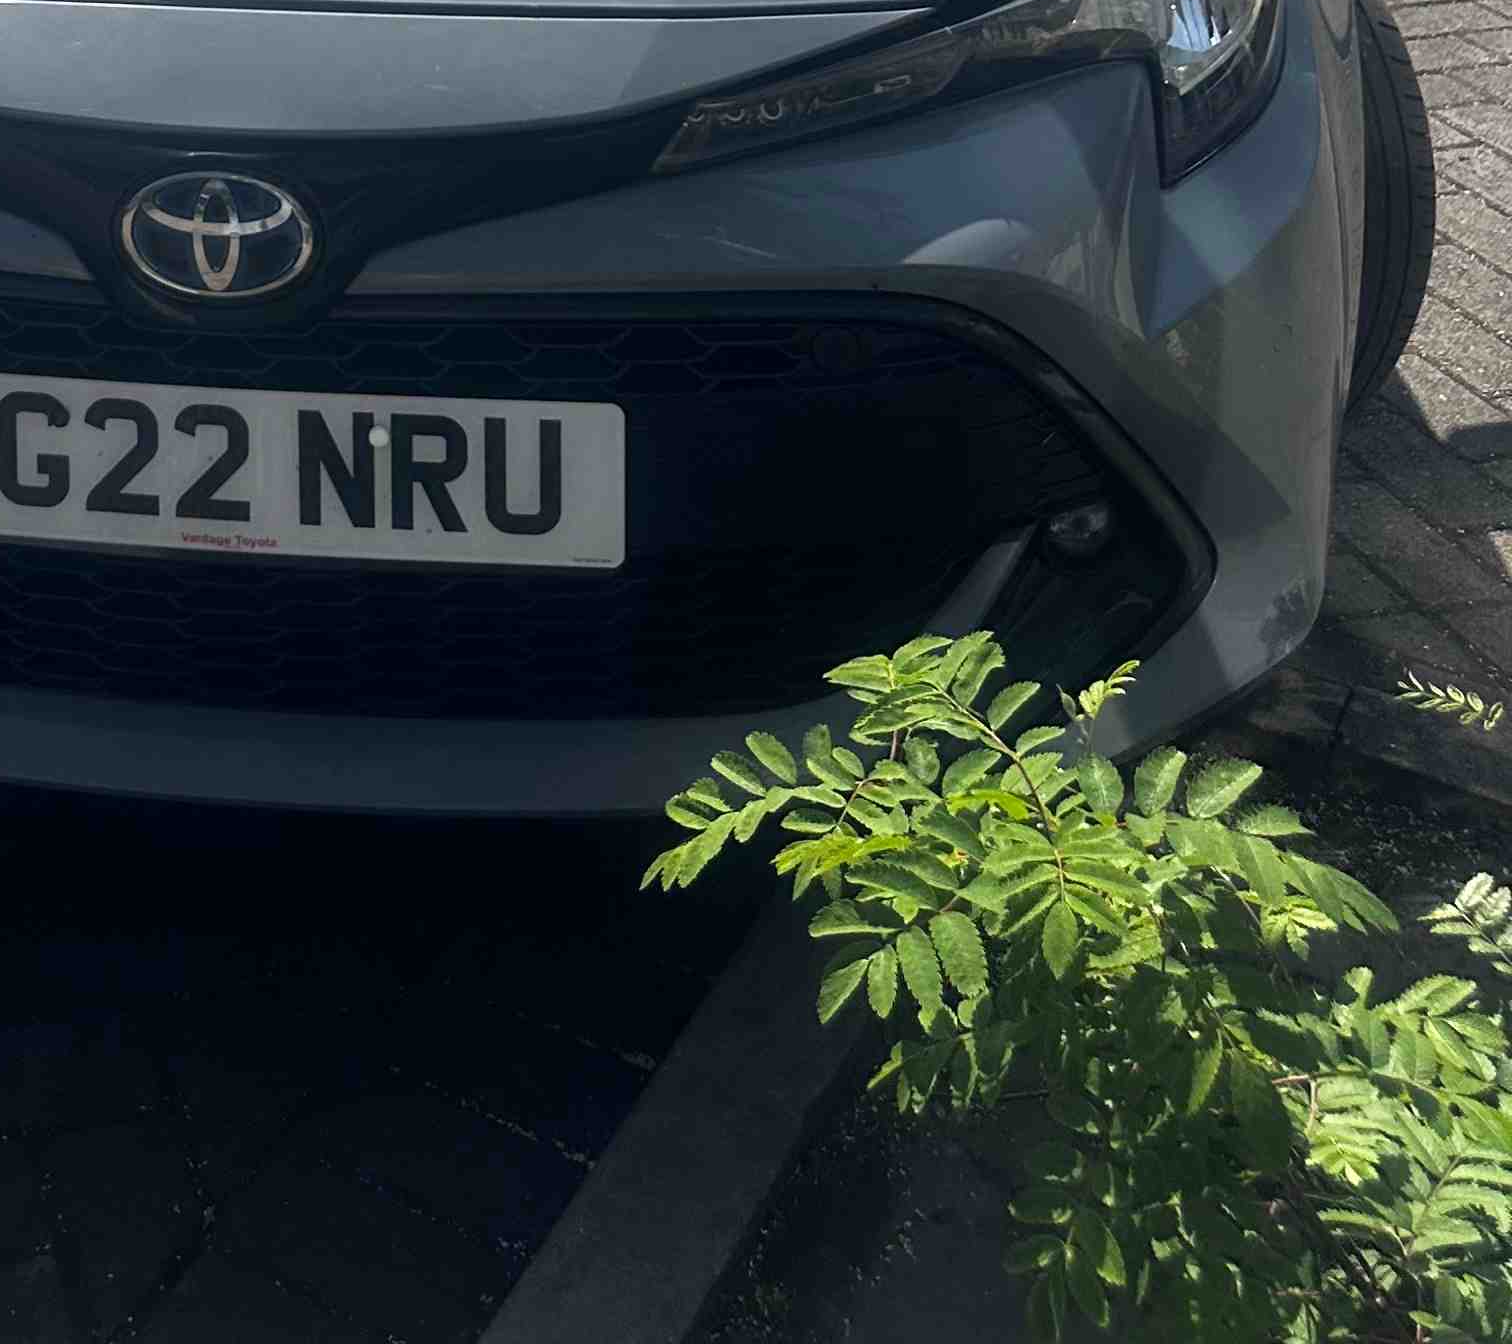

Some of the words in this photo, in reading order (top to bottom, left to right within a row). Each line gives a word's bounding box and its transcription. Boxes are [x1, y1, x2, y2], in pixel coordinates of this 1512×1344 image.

[297, 408, 563, 536] NRU
[181, 531, 232, 547] Vantage
[233, 534, 278, 549] Toyota
